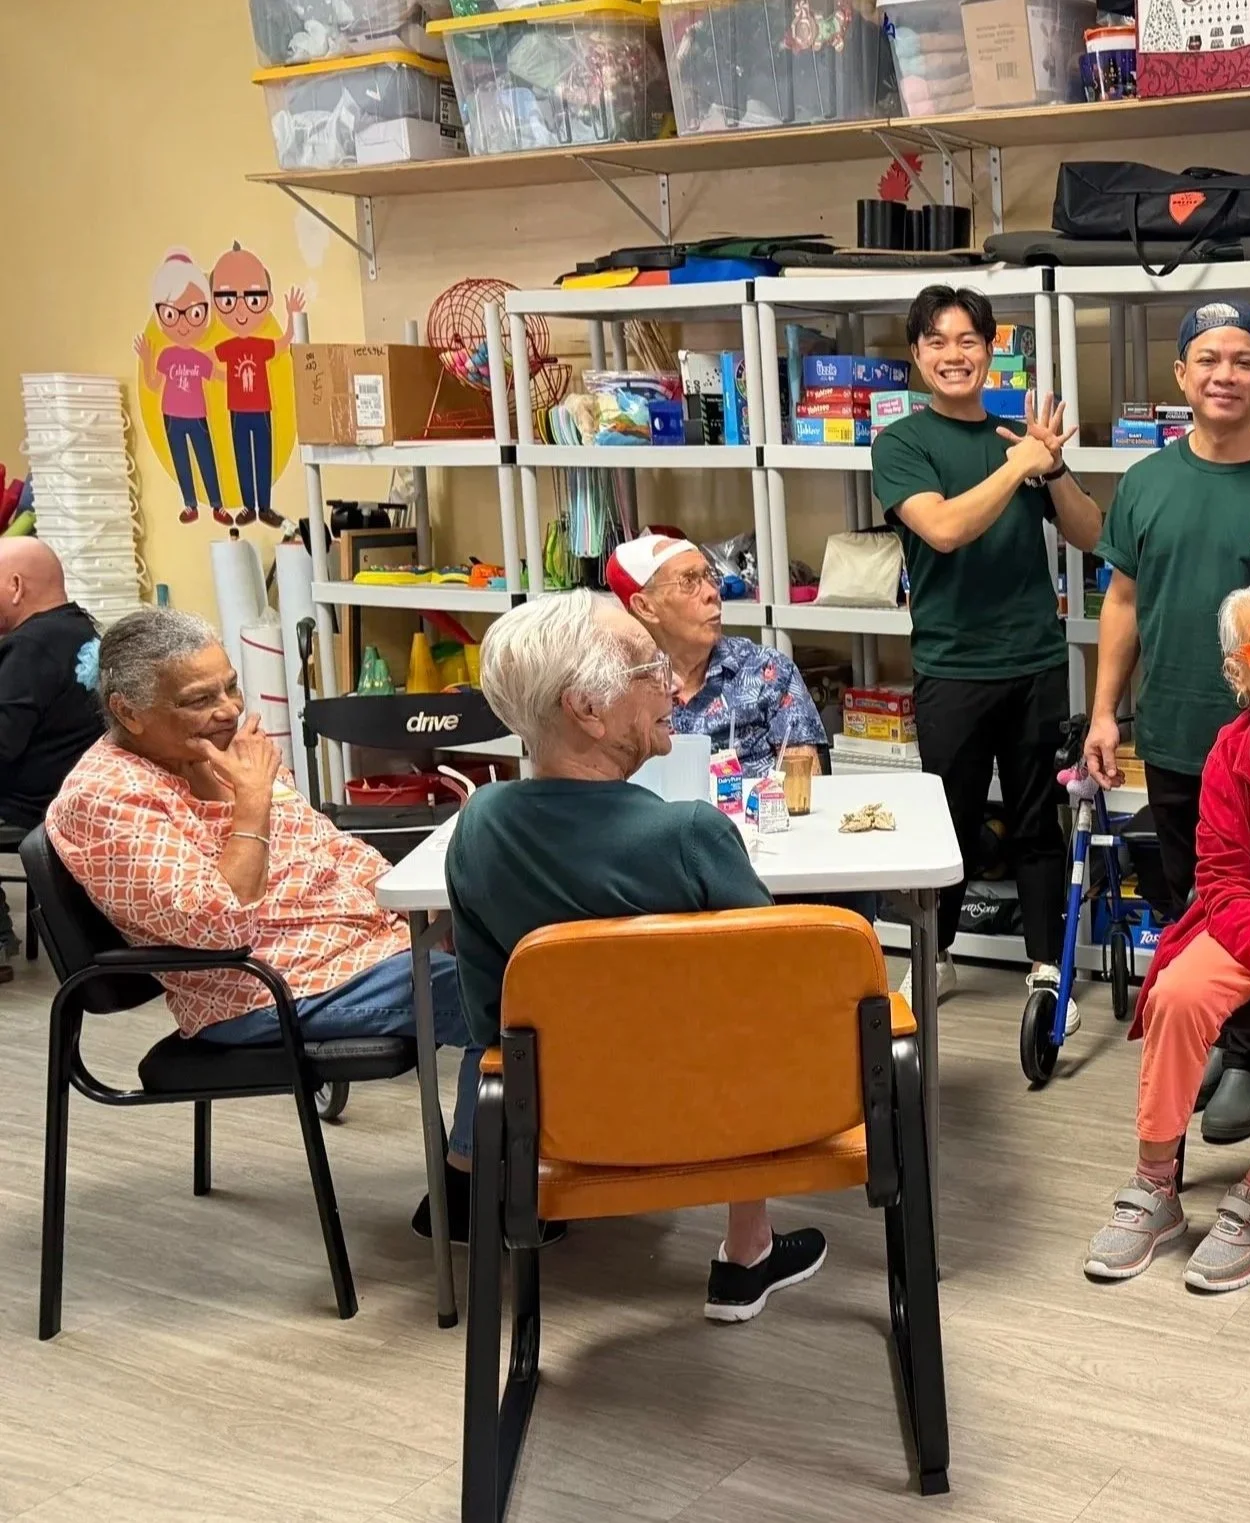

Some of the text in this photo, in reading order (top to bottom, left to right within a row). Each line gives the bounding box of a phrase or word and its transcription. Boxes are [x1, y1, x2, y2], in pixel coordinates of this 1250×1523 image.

[169, 363, 200, 380] Celebrate
[177, 376, 191, 393] Life
[406, 711, 460, 733] drive
